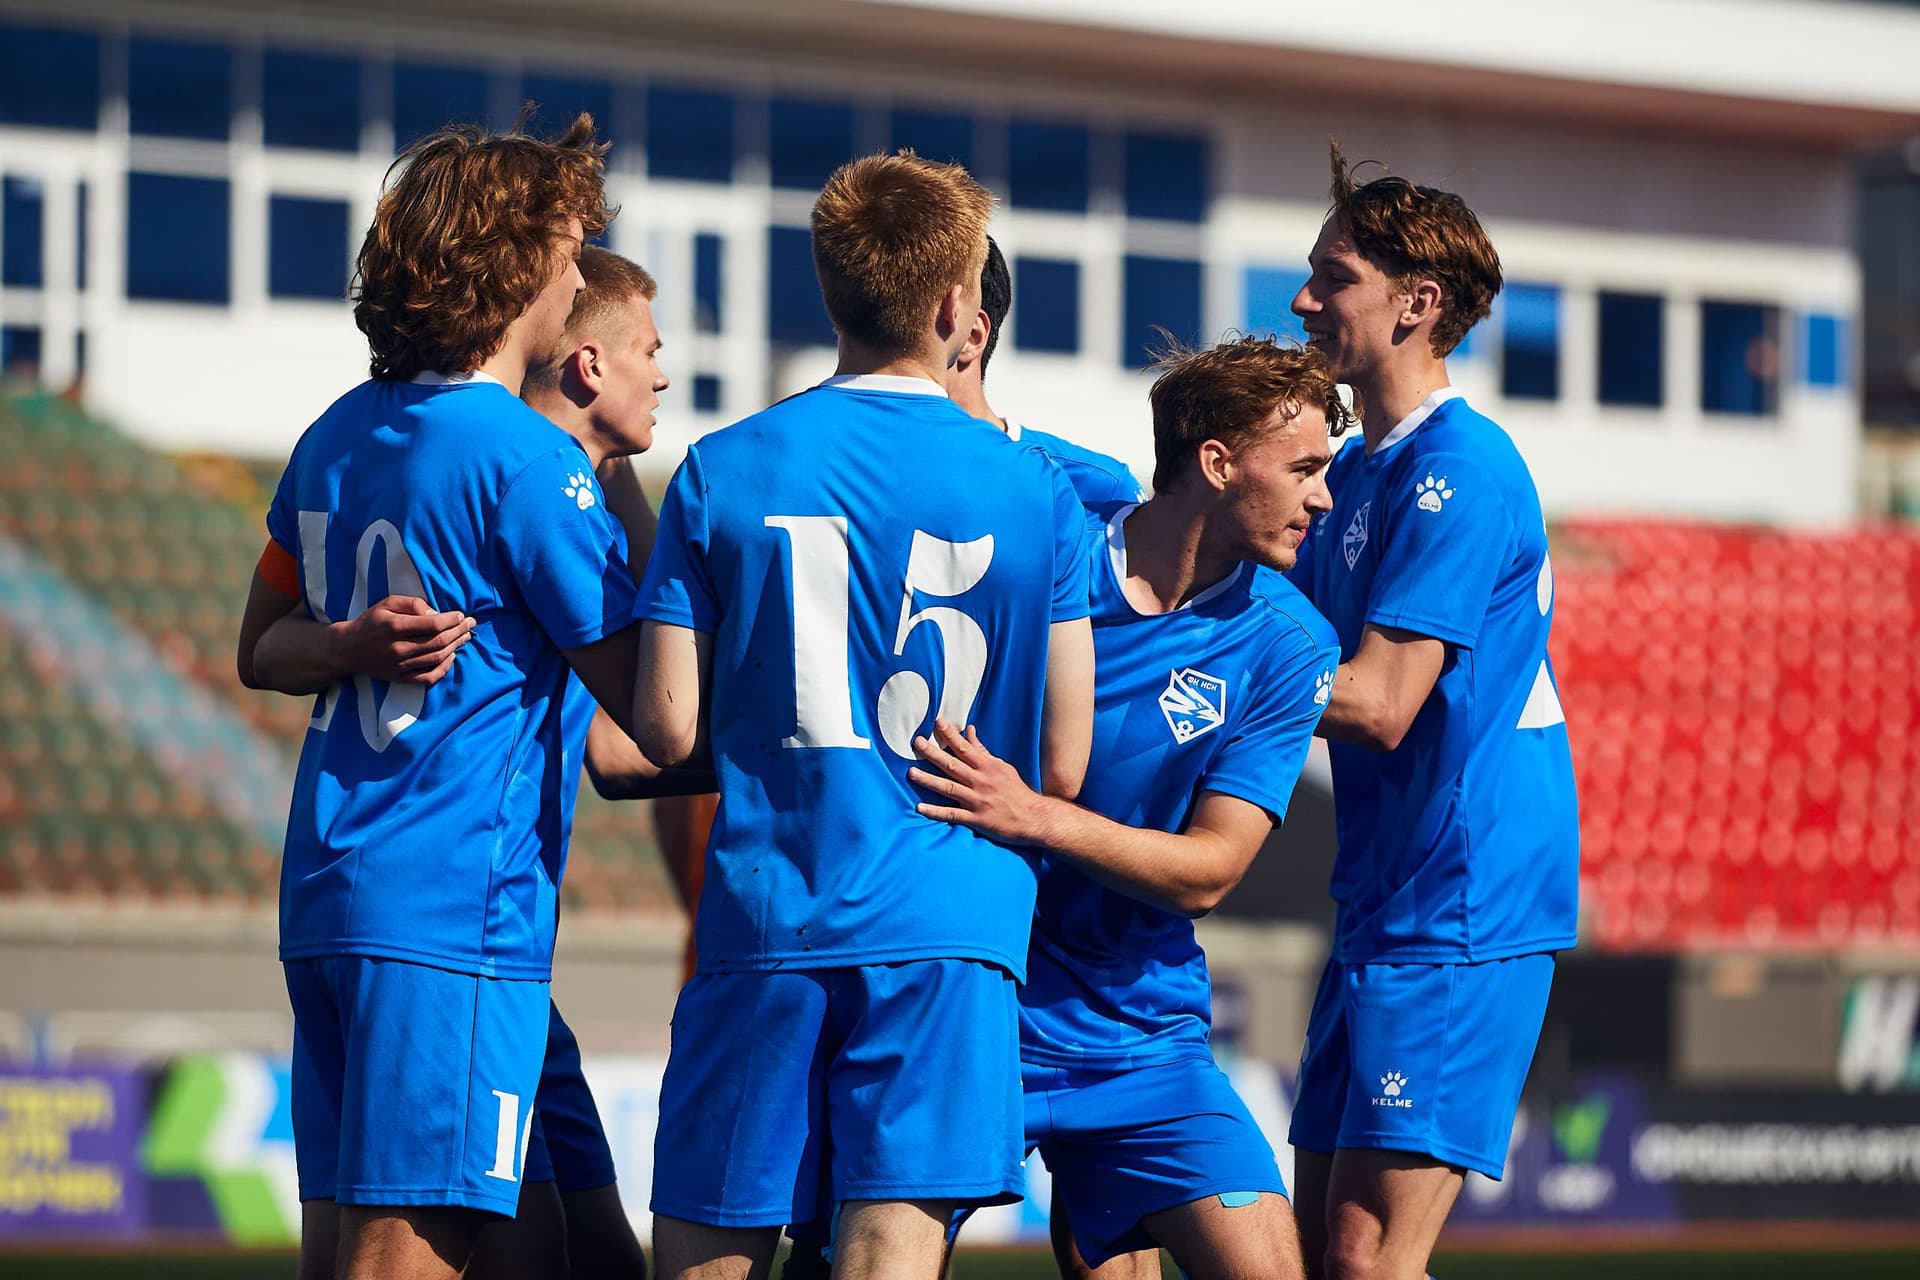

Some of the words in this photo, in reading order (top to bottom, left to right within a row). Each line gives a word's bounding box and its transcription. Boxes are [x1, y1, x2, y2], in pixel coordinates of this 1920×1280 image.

[764, 515, 995, 760] 15
[485, 1089, 535, 1183] 1
[1372, 1097, 1413, 1108] KELME
